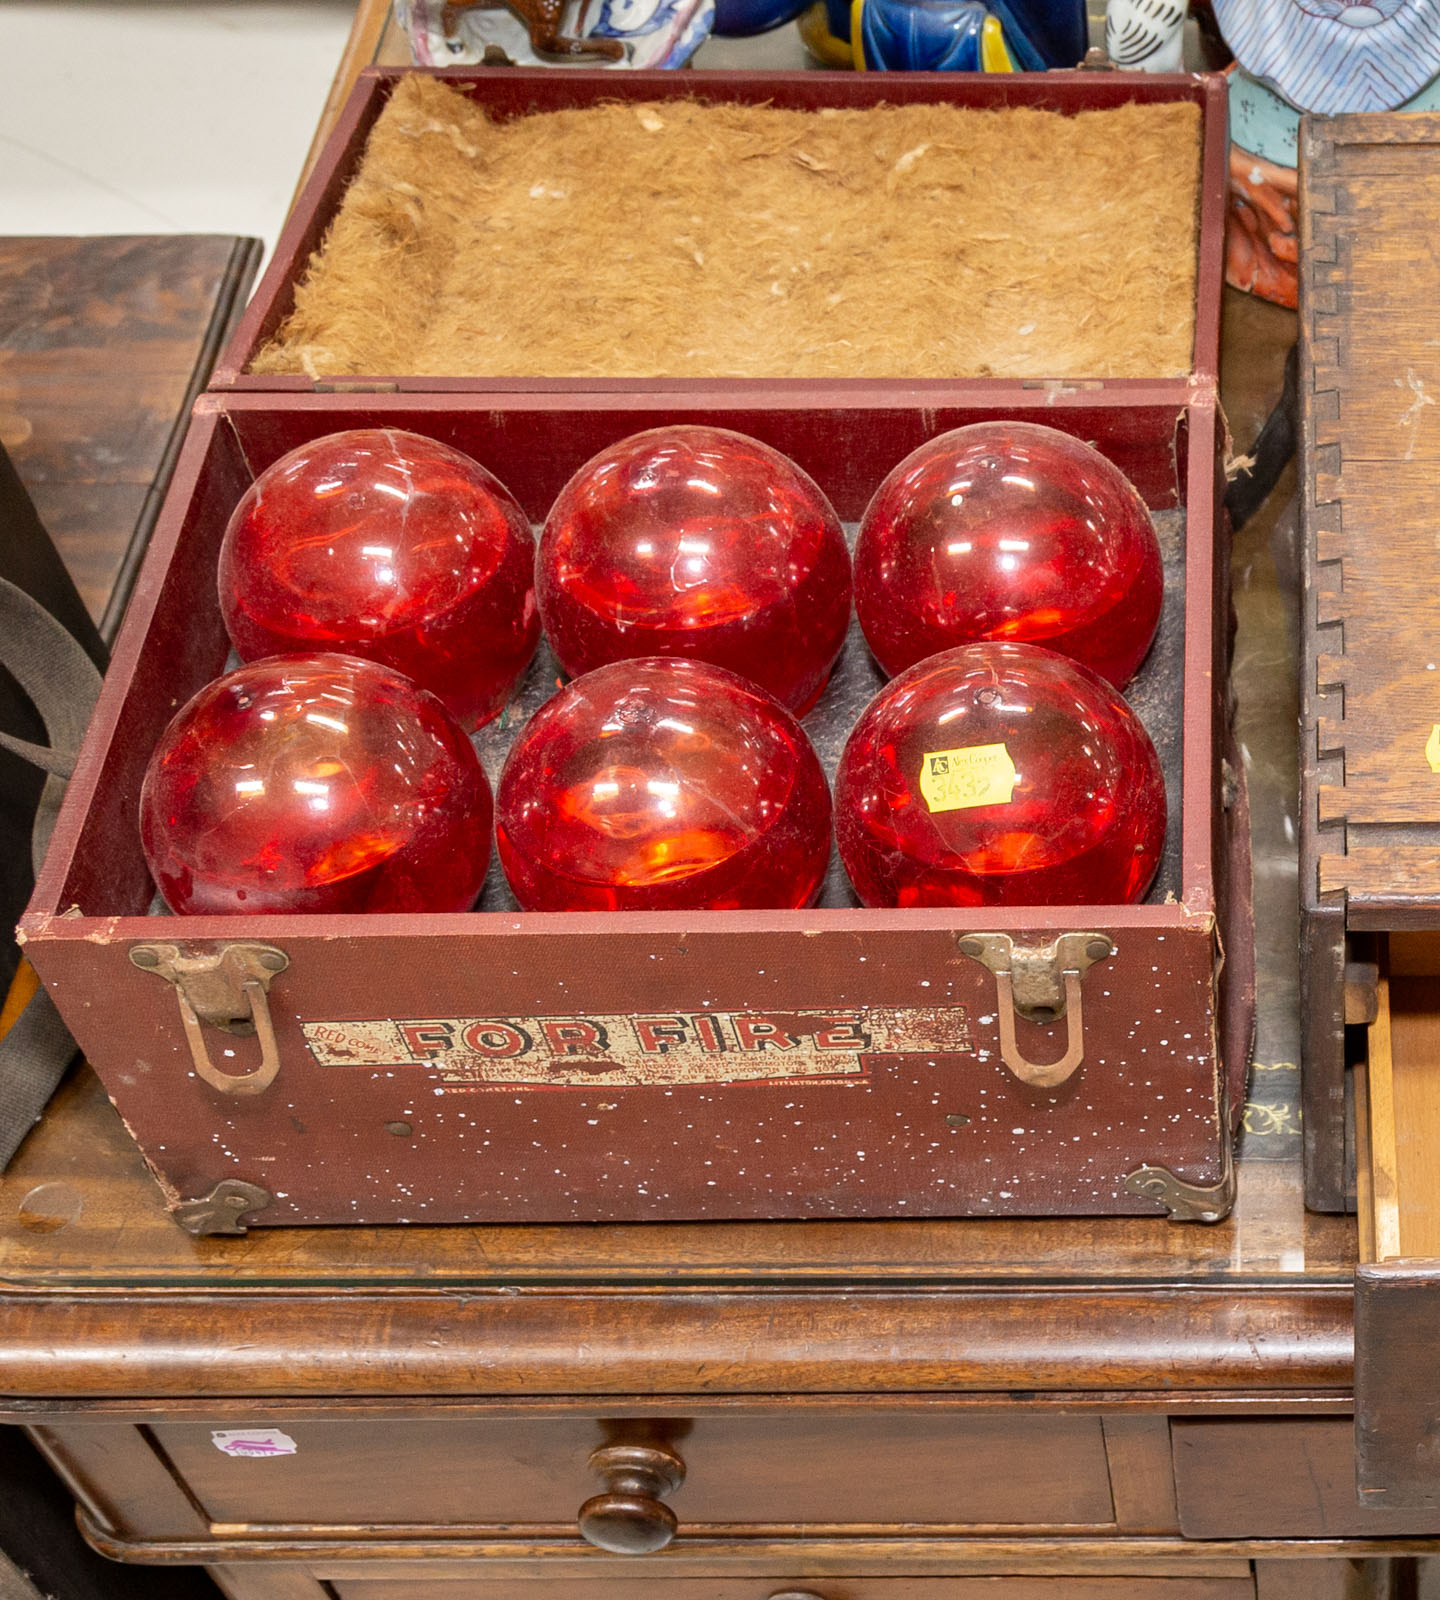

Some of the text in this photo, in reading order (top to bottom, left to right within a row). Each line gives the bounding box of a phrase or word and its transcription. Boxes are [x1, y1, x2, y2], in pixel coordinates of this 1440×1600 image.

[314, 1026, 386, 1056] RED COMET
[397, 1019, 611, 1060] FOR
[632, 1014, 871, 1054] FIRE
